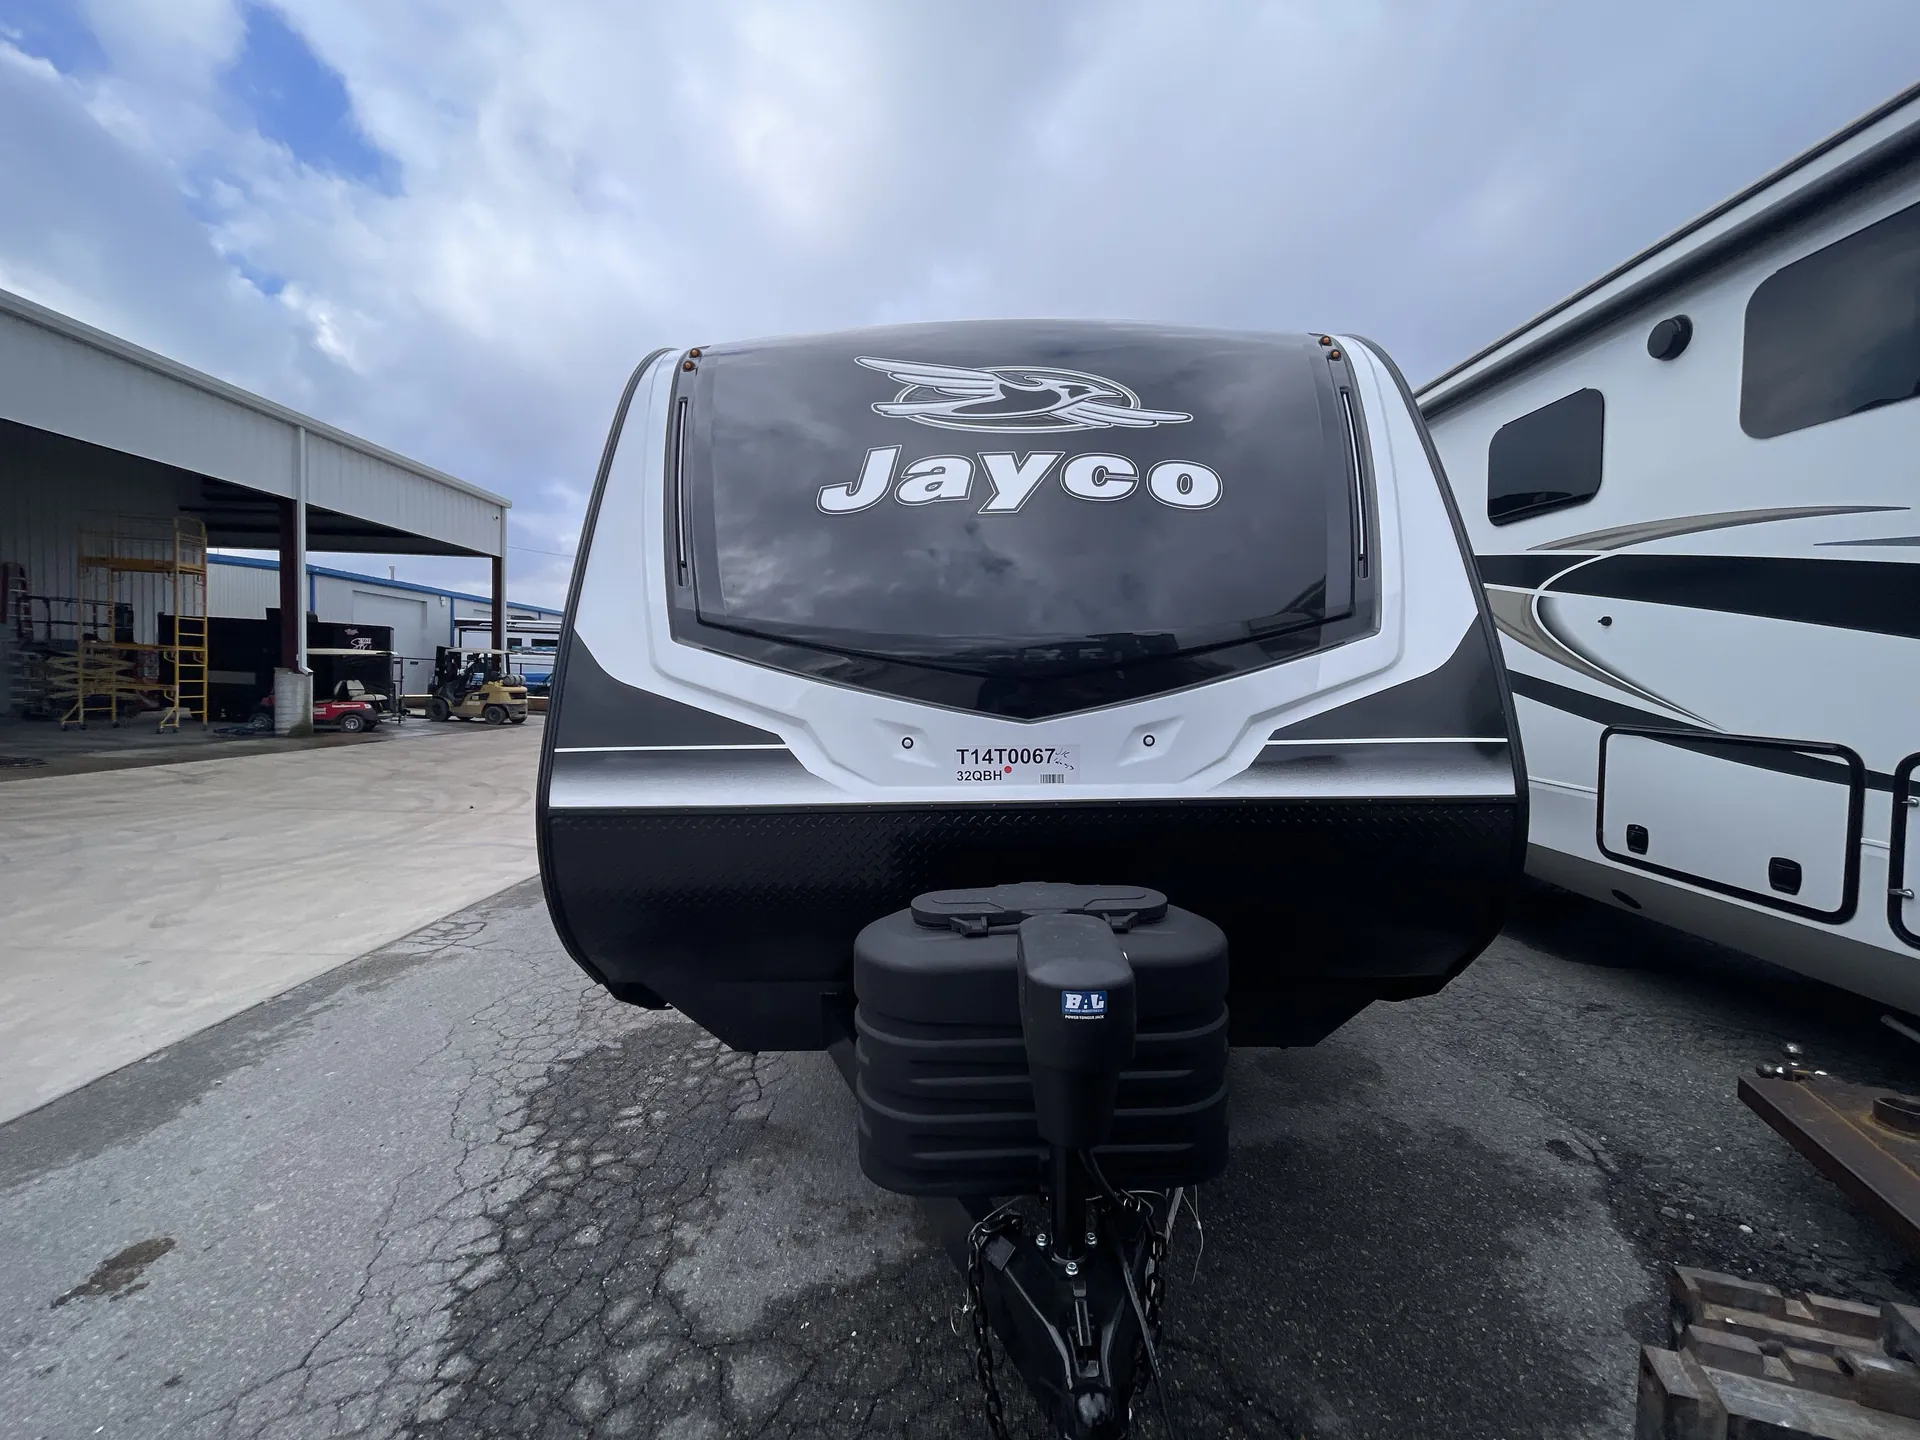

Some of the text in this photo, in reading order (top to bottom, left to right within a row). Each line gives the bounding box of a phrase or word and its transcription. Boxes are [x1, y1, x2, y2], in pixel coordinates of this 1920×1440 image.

[816, 444, 1224, 515] Jayco
[956, 748, 1055, 765] T14T0067
[956, 770, 1002, 781] 32QBH
